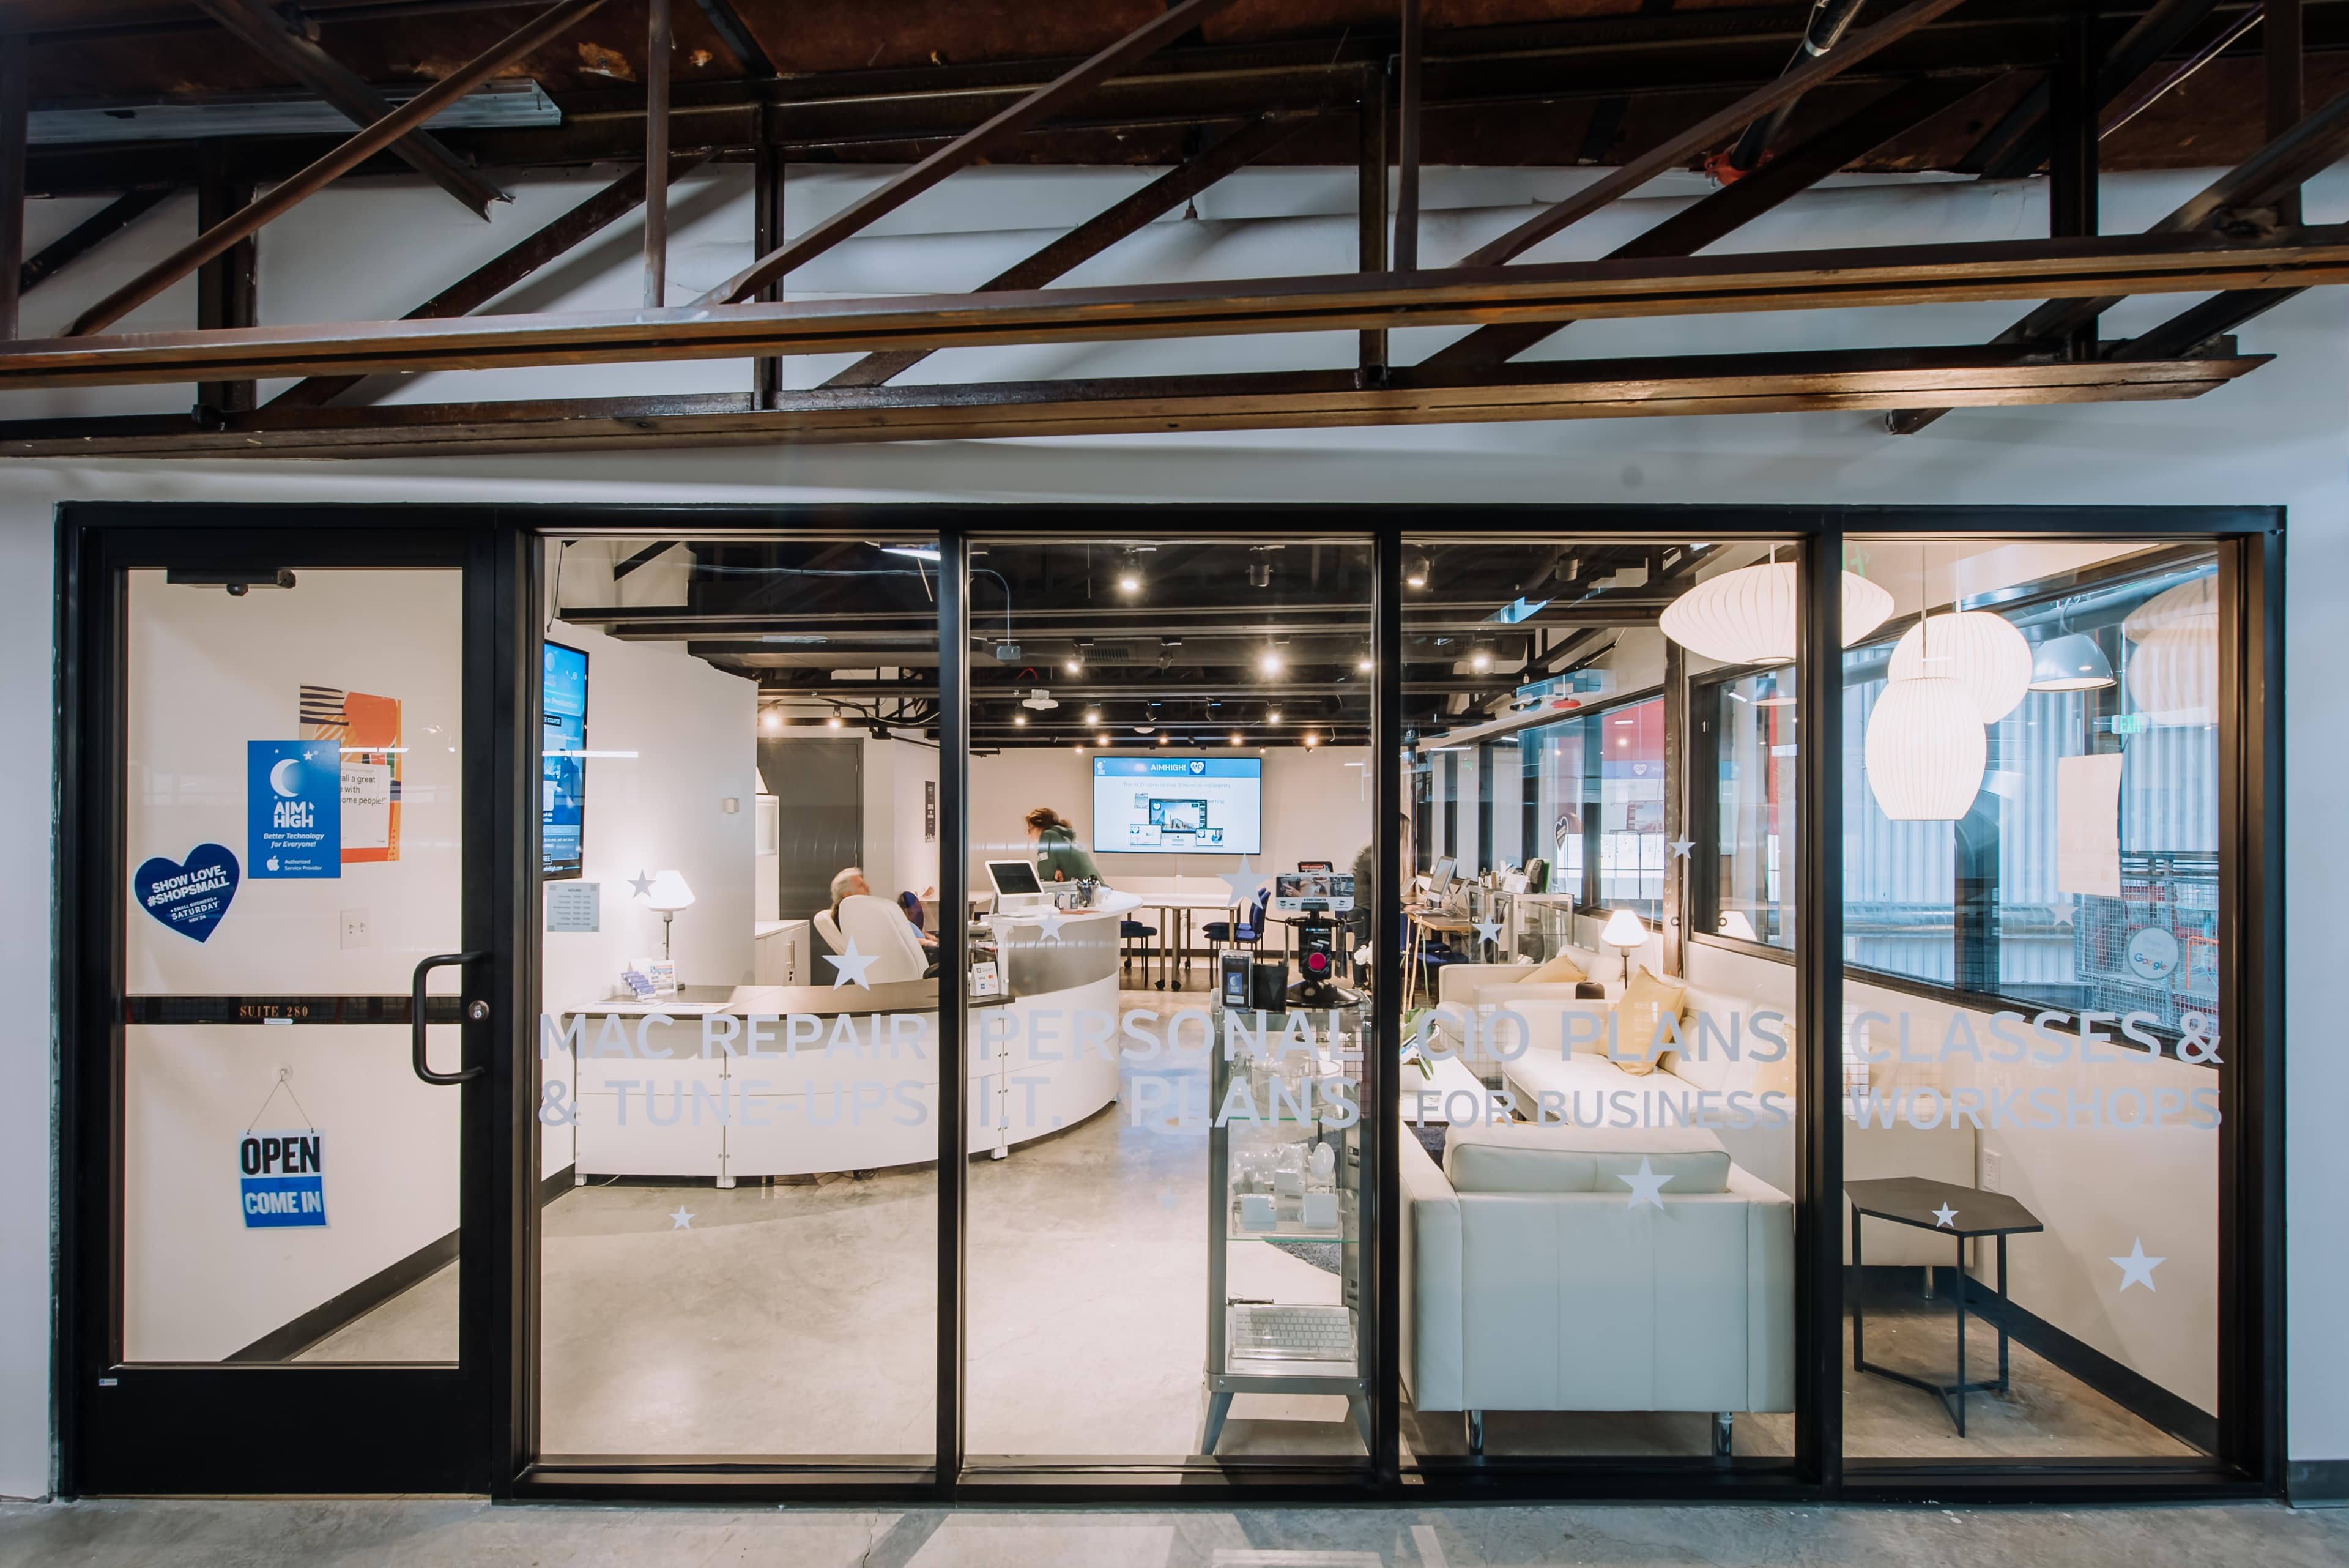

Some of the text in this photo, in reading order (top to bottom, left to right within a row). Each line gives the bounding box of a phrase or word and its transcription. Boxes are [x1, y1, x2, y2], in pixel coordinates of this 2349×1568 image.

[357, 776, 376, 784] great
[273, 814, 313, 828] HIGH
[274, 801, 306, 815] AIM
[147, 876, 230, 907] #SHOPSMALL
[152, 865, 227, 893] SHOW LOVE,
[171, 901, 218, 920] SATURDAY
[190, 897, 213, 908] BUSINESS
[2134, 953, 2167, 970] Google
[240, 1006, 308, 1017] SUITE 280
[539, 1013, 928, 1060] MAC REPAIR
[979, 1009, 1364, 1061] PERSONAL
[1416, 1010, 1788, 1063] CIO PLANS
[538, 1080, 928, 1126] & TUNE-UPS
[979, 1076, 1360, 1129] I.T. PLANS
[1416, 1090, 1789, 1129] FOR BUSINESS
[1848, 1087, 2222, 1130] WORKSHOPS
[241, 1136, 321, 1175] OPEN
[245, 1191, 322, 1214] COME IN
